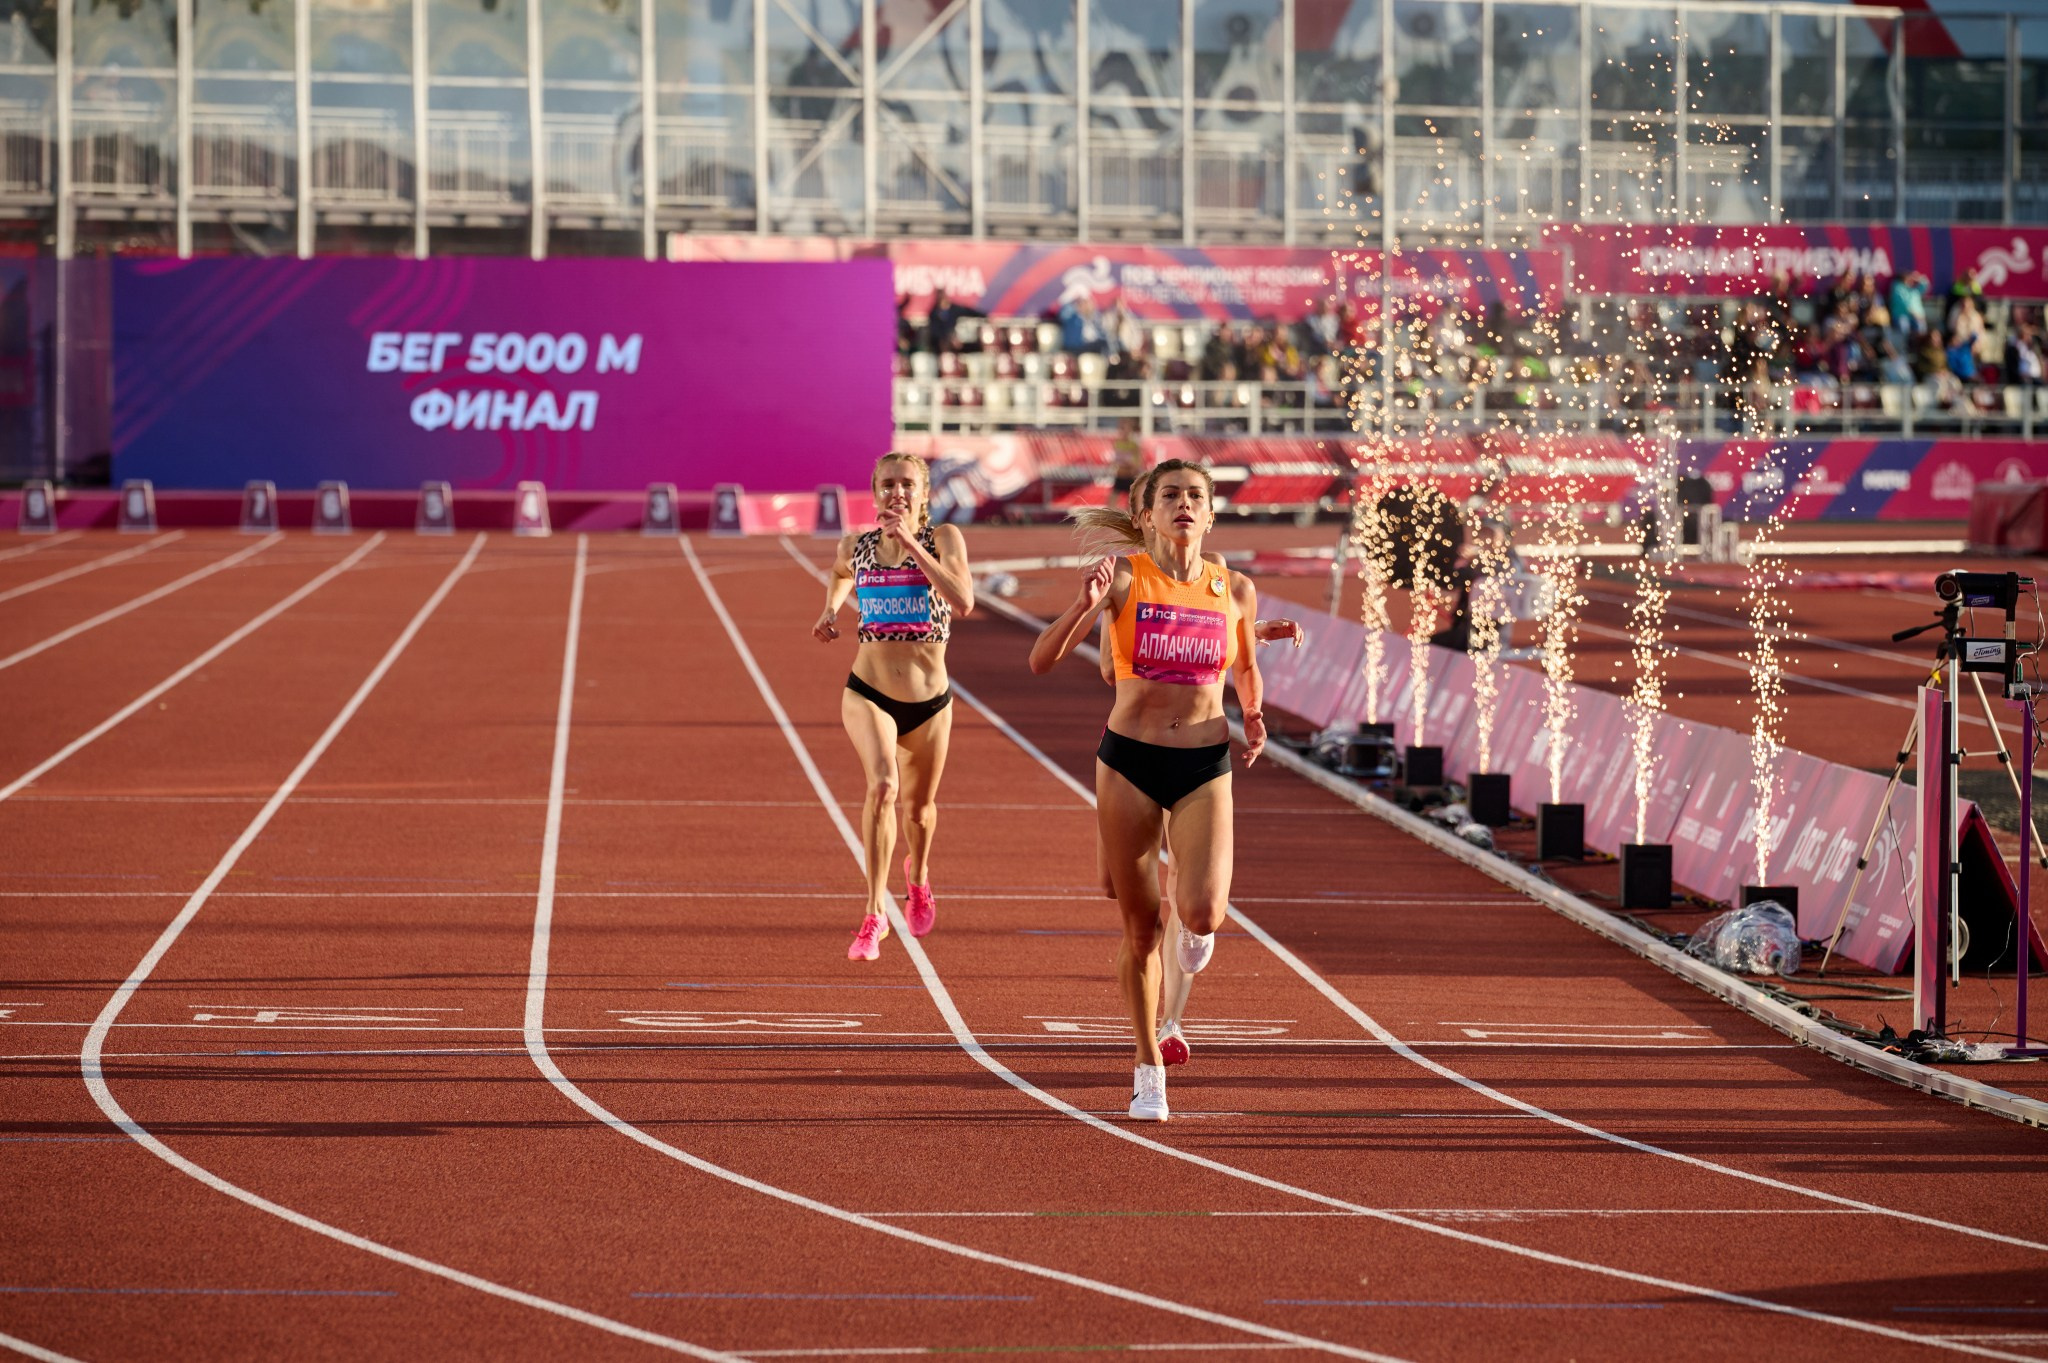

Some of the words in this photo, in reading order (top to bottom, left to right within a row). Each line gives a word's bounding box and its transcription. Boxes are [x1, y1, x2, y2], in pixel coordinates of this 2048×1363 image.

[1759, 247, 1892, 277] ТРИБУНА
[366, 332, 463, 372] БЕГ
[465, 332, 588, 373] 5000
[596, 333, 643, 373] М
[410, 388, 599, 431] ФИНАЛ
[651, 493, 669, 522] 3
[719, 493, 736, 522] 2
[822, 493, 835, 522] 1
[868, 575, 885, 583] ПСБ
[861, 597, 927, 617] ДУБРОВСКАЯ
[1156, 610, 1177, 620] ПСБ
[1137, 632, 1221, 665] АПЛАЧКИНА
[1974, 647, 2002, 657] eTiming
